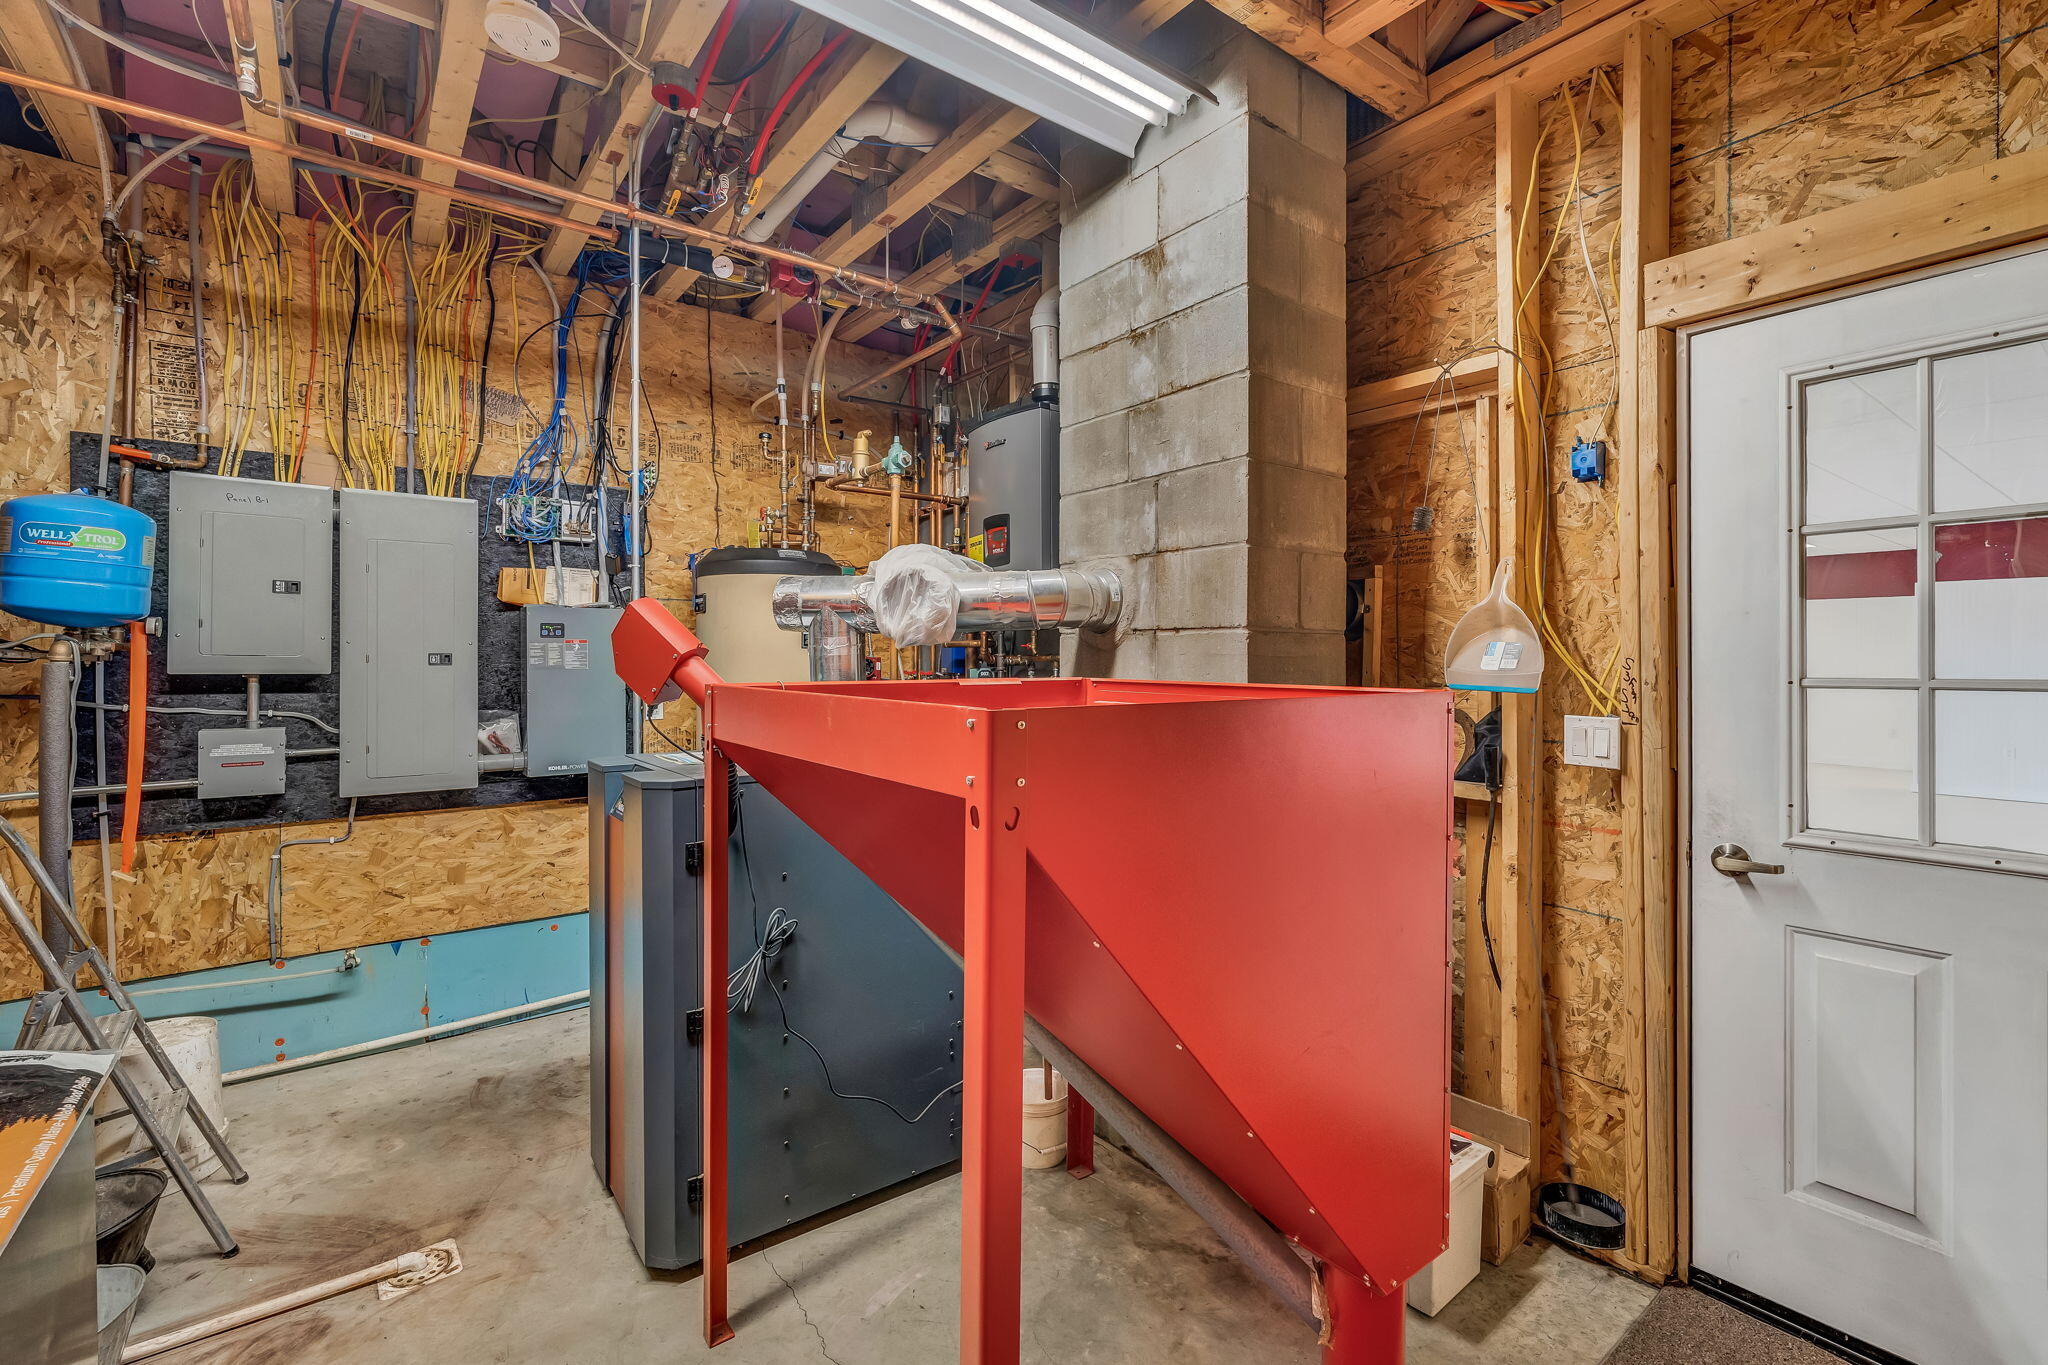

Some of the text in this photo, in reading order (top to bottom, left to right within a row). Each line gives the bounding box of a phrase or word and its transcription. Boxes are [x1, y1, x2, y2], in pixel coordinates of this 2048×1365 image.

[226, 492, 252, 504] Panel
[37, 539, 72, 547] Professional
[2, 1162, 39, 1198] Premium
[25, 1141, 56, 1164] Quality
